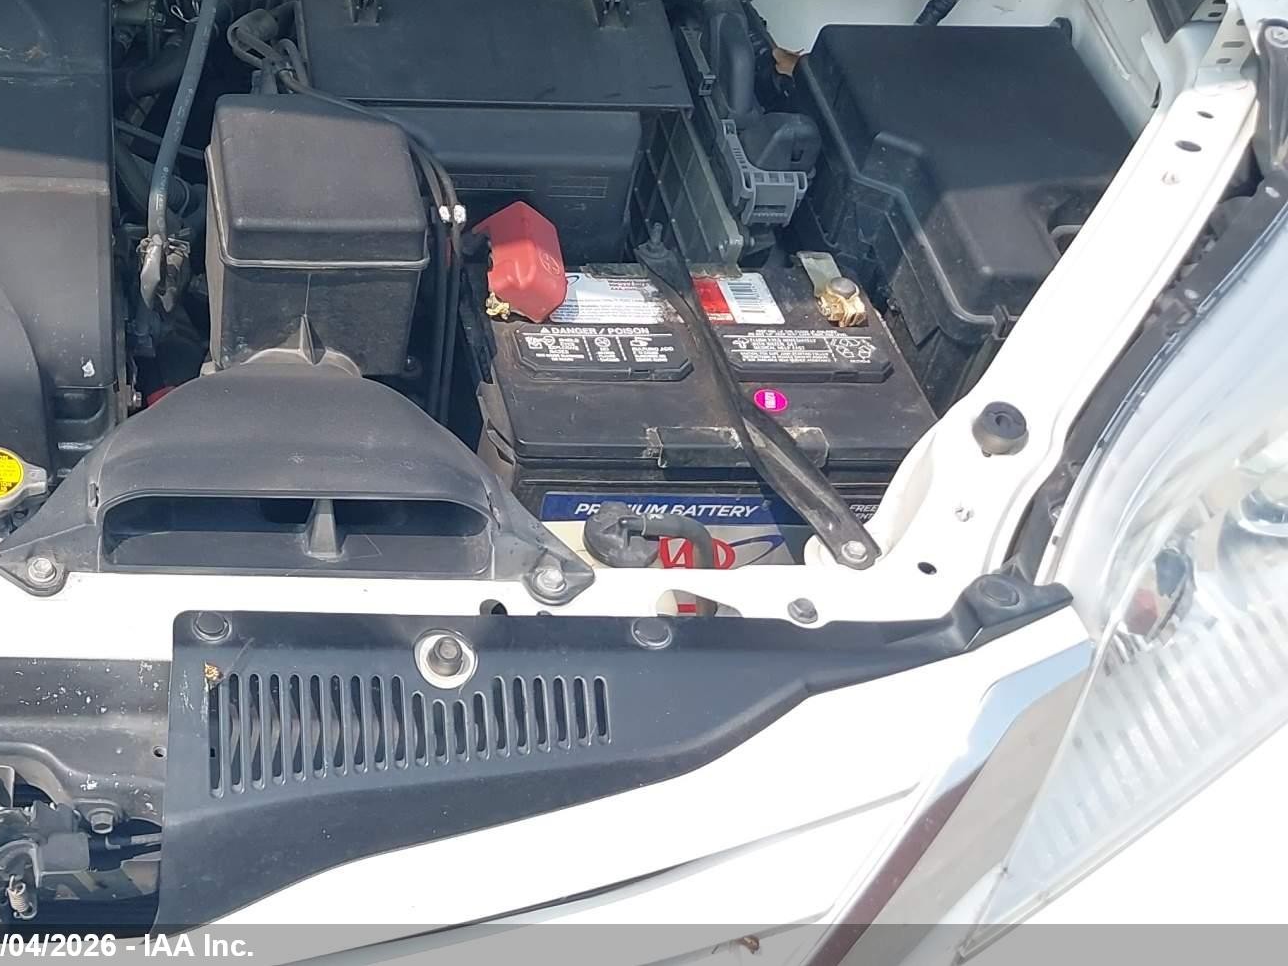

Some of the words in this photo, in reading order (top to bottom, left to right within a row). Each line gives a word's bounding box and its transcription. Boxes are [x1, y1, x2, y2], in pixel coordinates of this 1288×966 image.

[550, 327, 598, 335] DANGER
[607, 327, 650, 336] POISON
[574, 503, 669, 516] PRIUM
[670, 504, 760, 517] BATTERY
